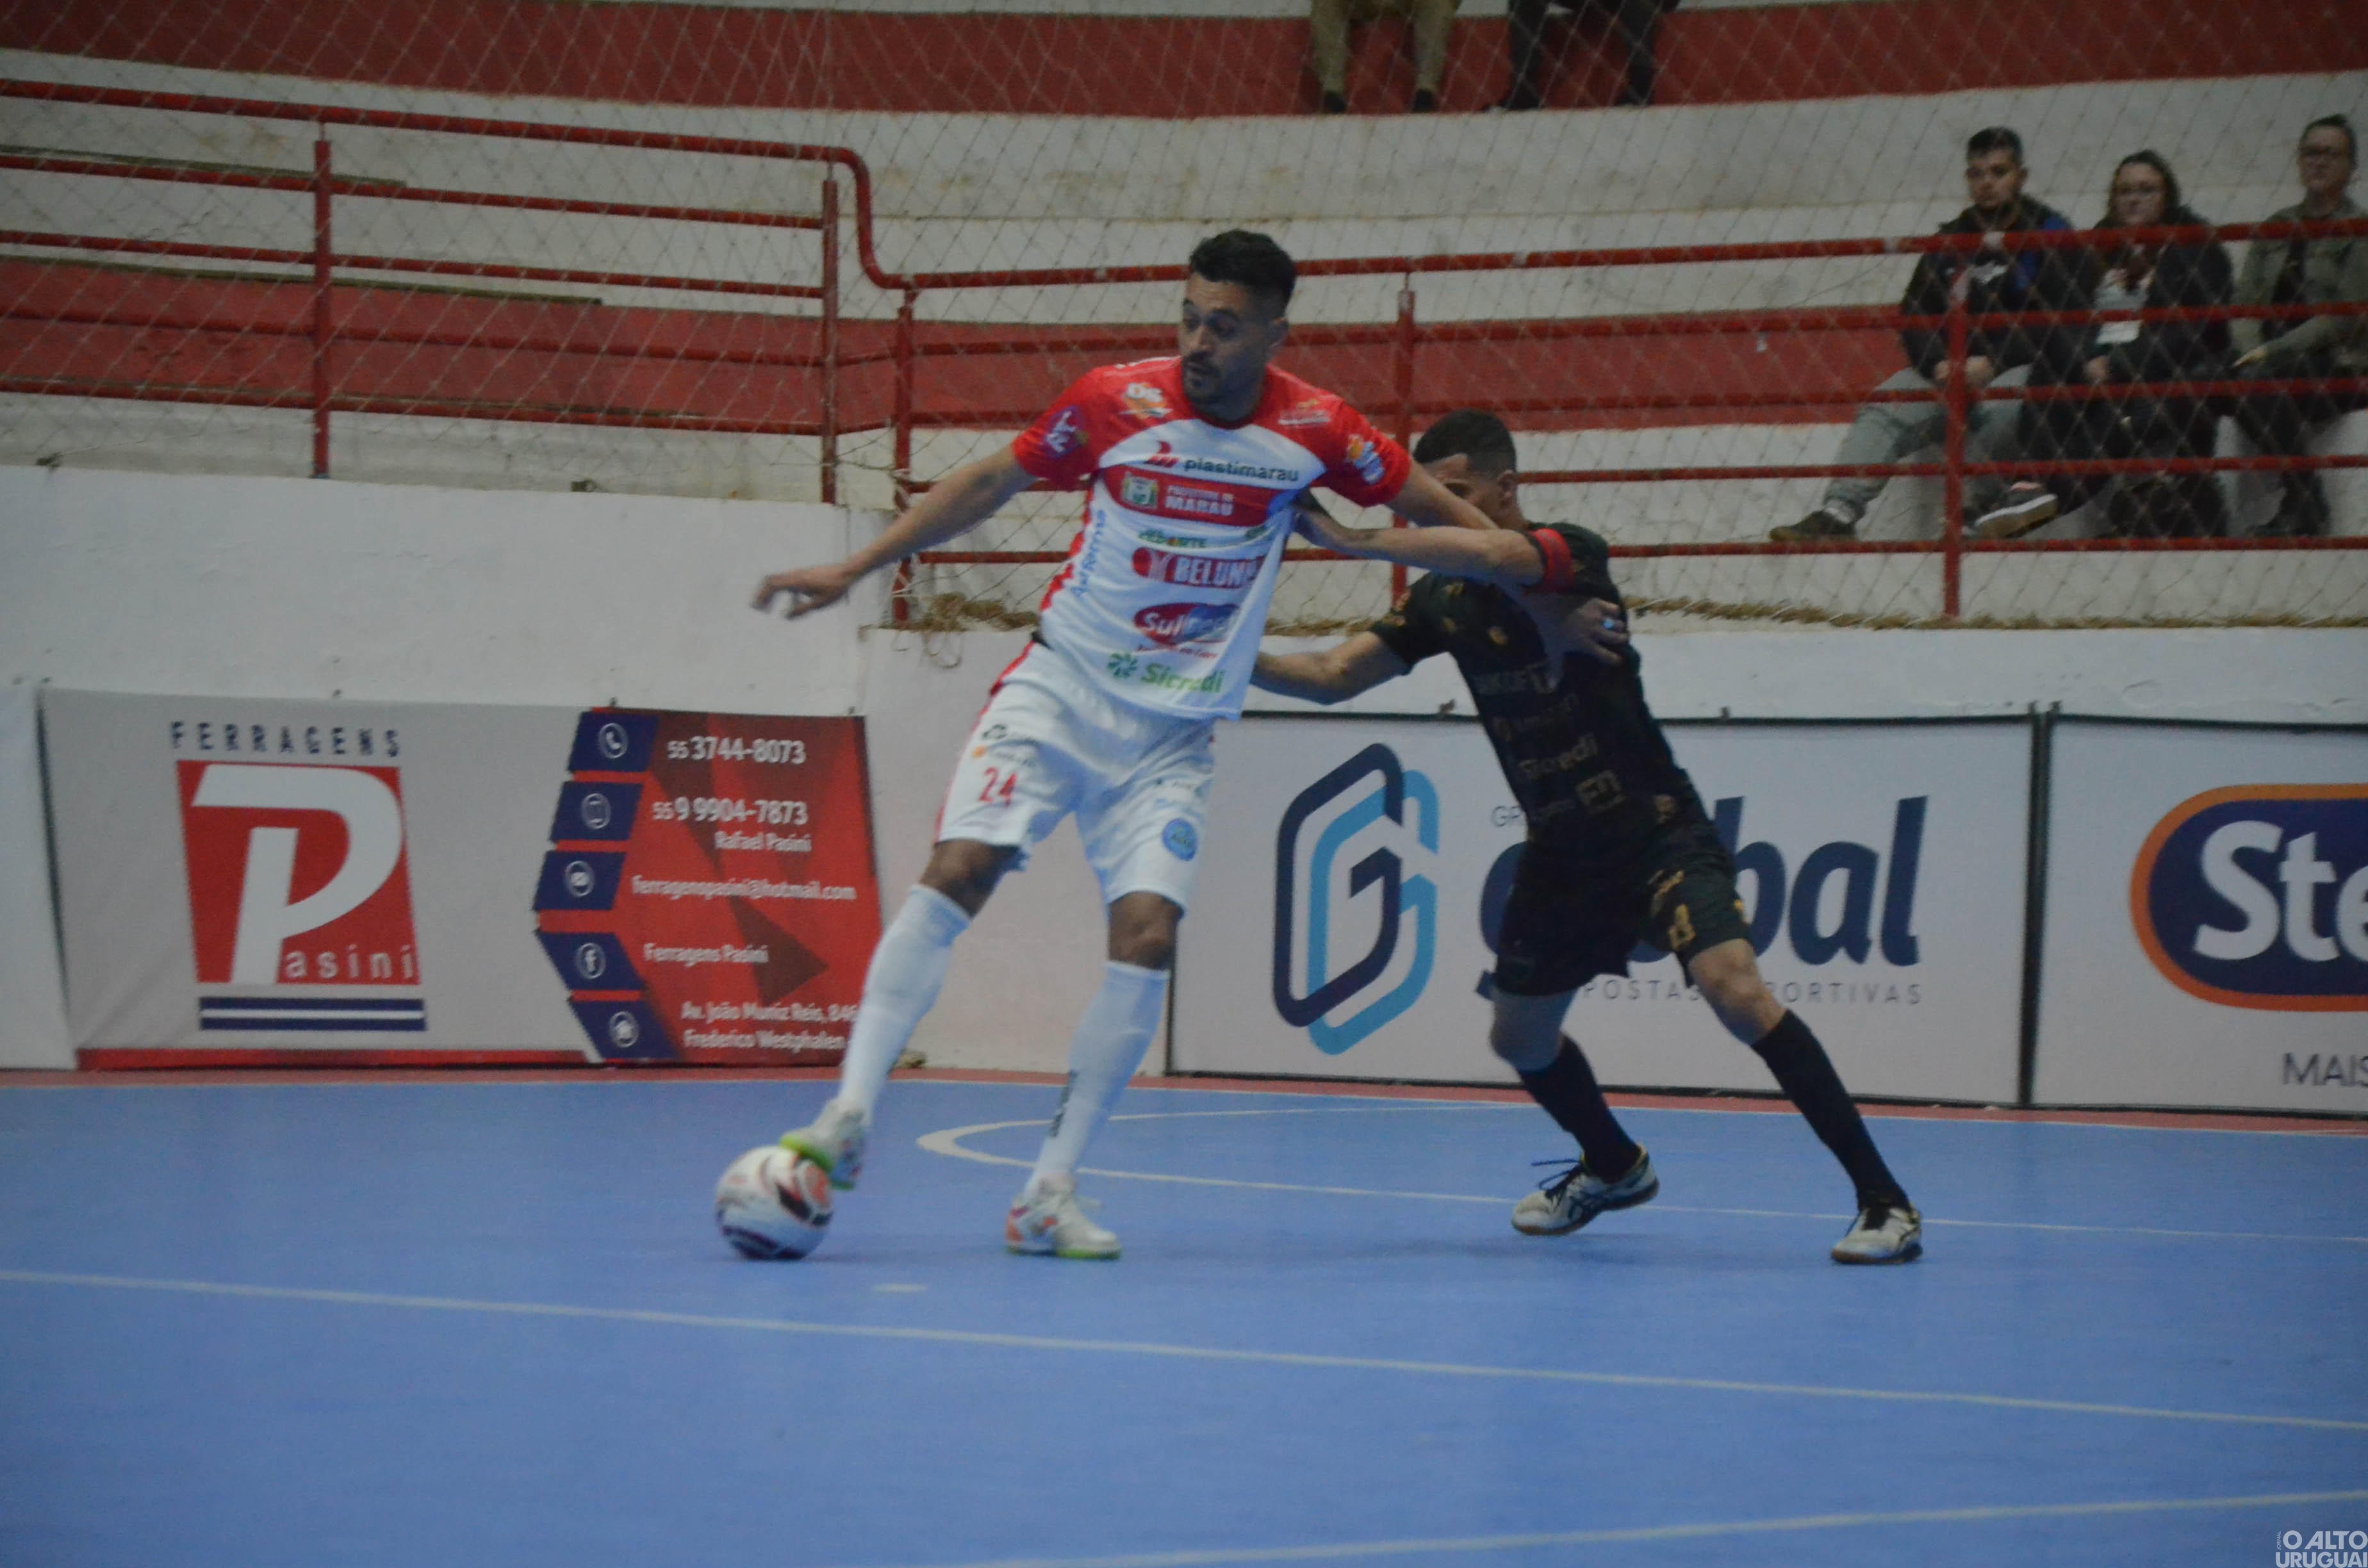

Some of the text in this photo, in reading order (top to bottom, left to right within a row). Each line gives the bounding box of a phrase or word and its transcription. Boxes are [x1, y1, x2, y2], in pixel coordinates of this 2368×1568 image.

[1185, 457, 1299, 482] plastimarau
[1140, 662, 1224, 693] Sicredi
[170, 721, 400, 757] FERRAGENS
[690, 735, 807, 764] 3744-8073
[979, 766, 1017, 808] 24
[675, 796, 690, 821] 9
[1581, 979, 1921, 1005] POSTAS ORTIVAS
